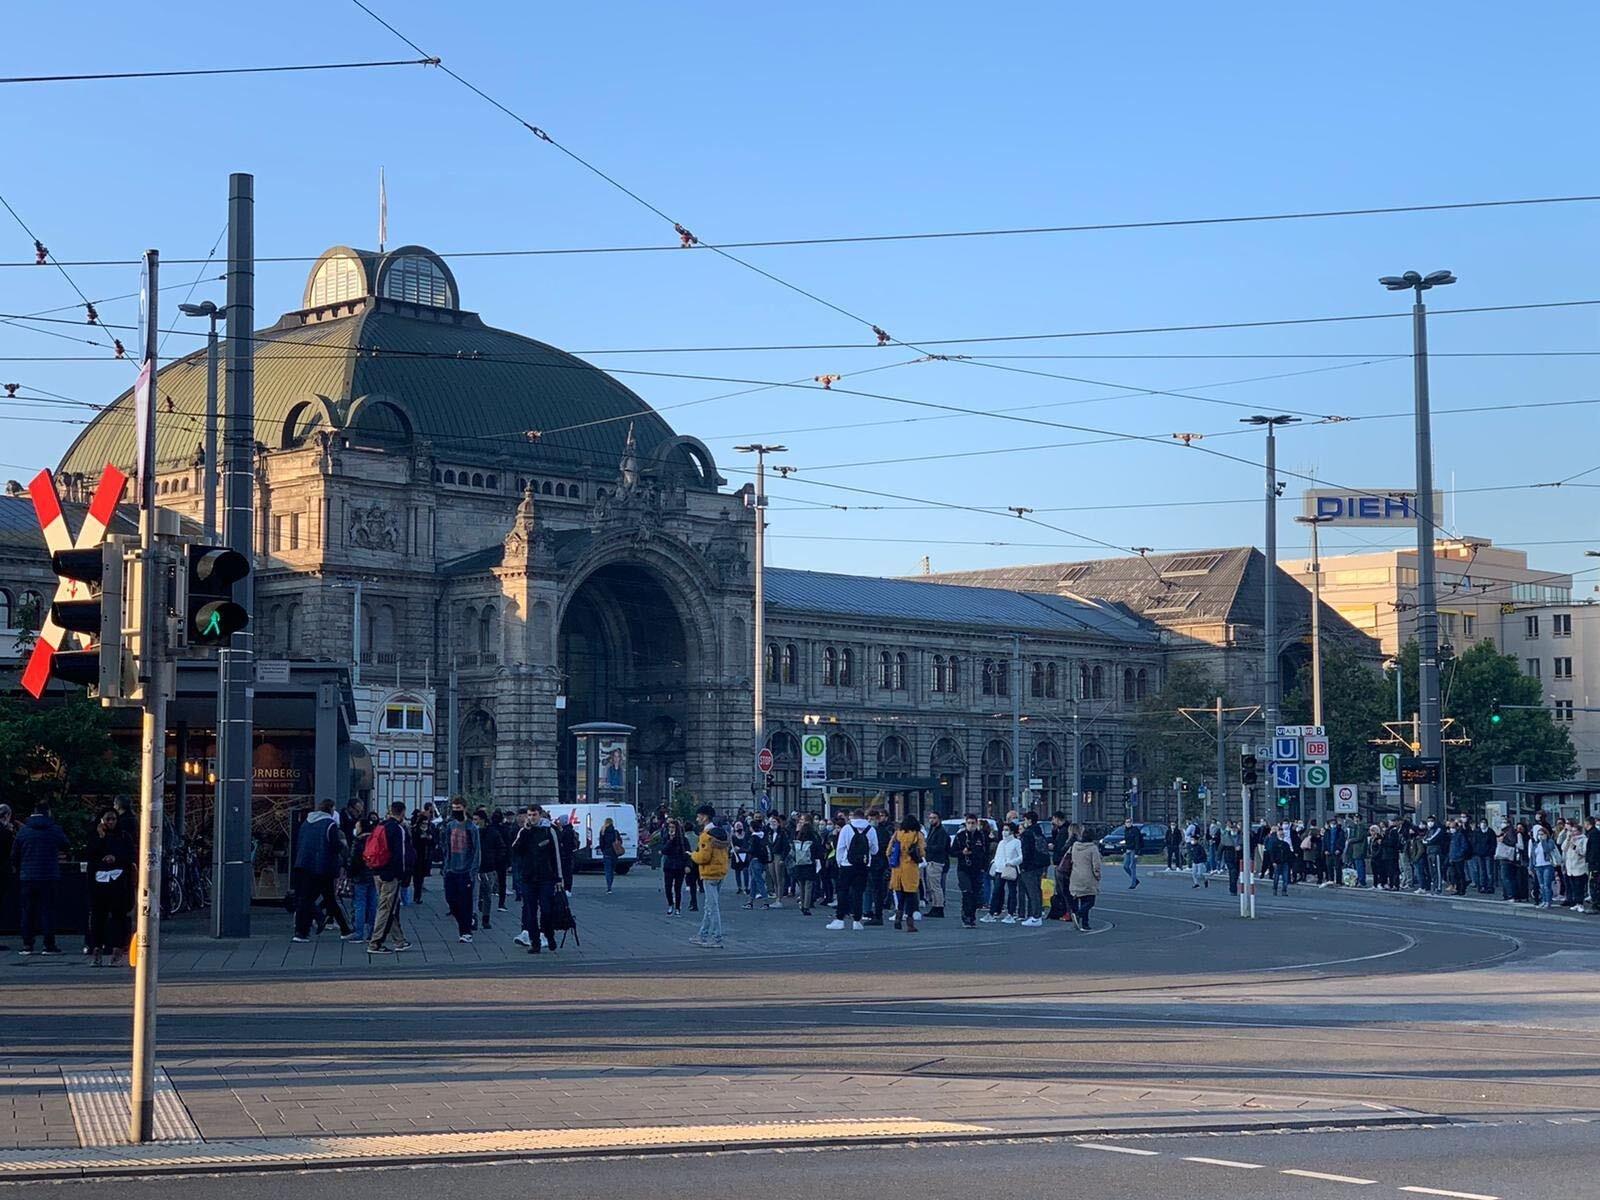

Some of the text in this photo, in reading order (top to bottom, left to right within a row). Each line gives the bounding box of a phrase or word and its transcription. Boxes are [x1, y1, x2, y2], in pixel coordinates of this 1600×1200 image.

[1317, 497, 1417, 518] DIEH
[809, 740, 819, 752] H
[1278, 740, 1295, 758] U
[1309, 743, 1324, 754] DB
[759, 755, 771, 765] STOP
[1311, 768, 1324, 783] S
